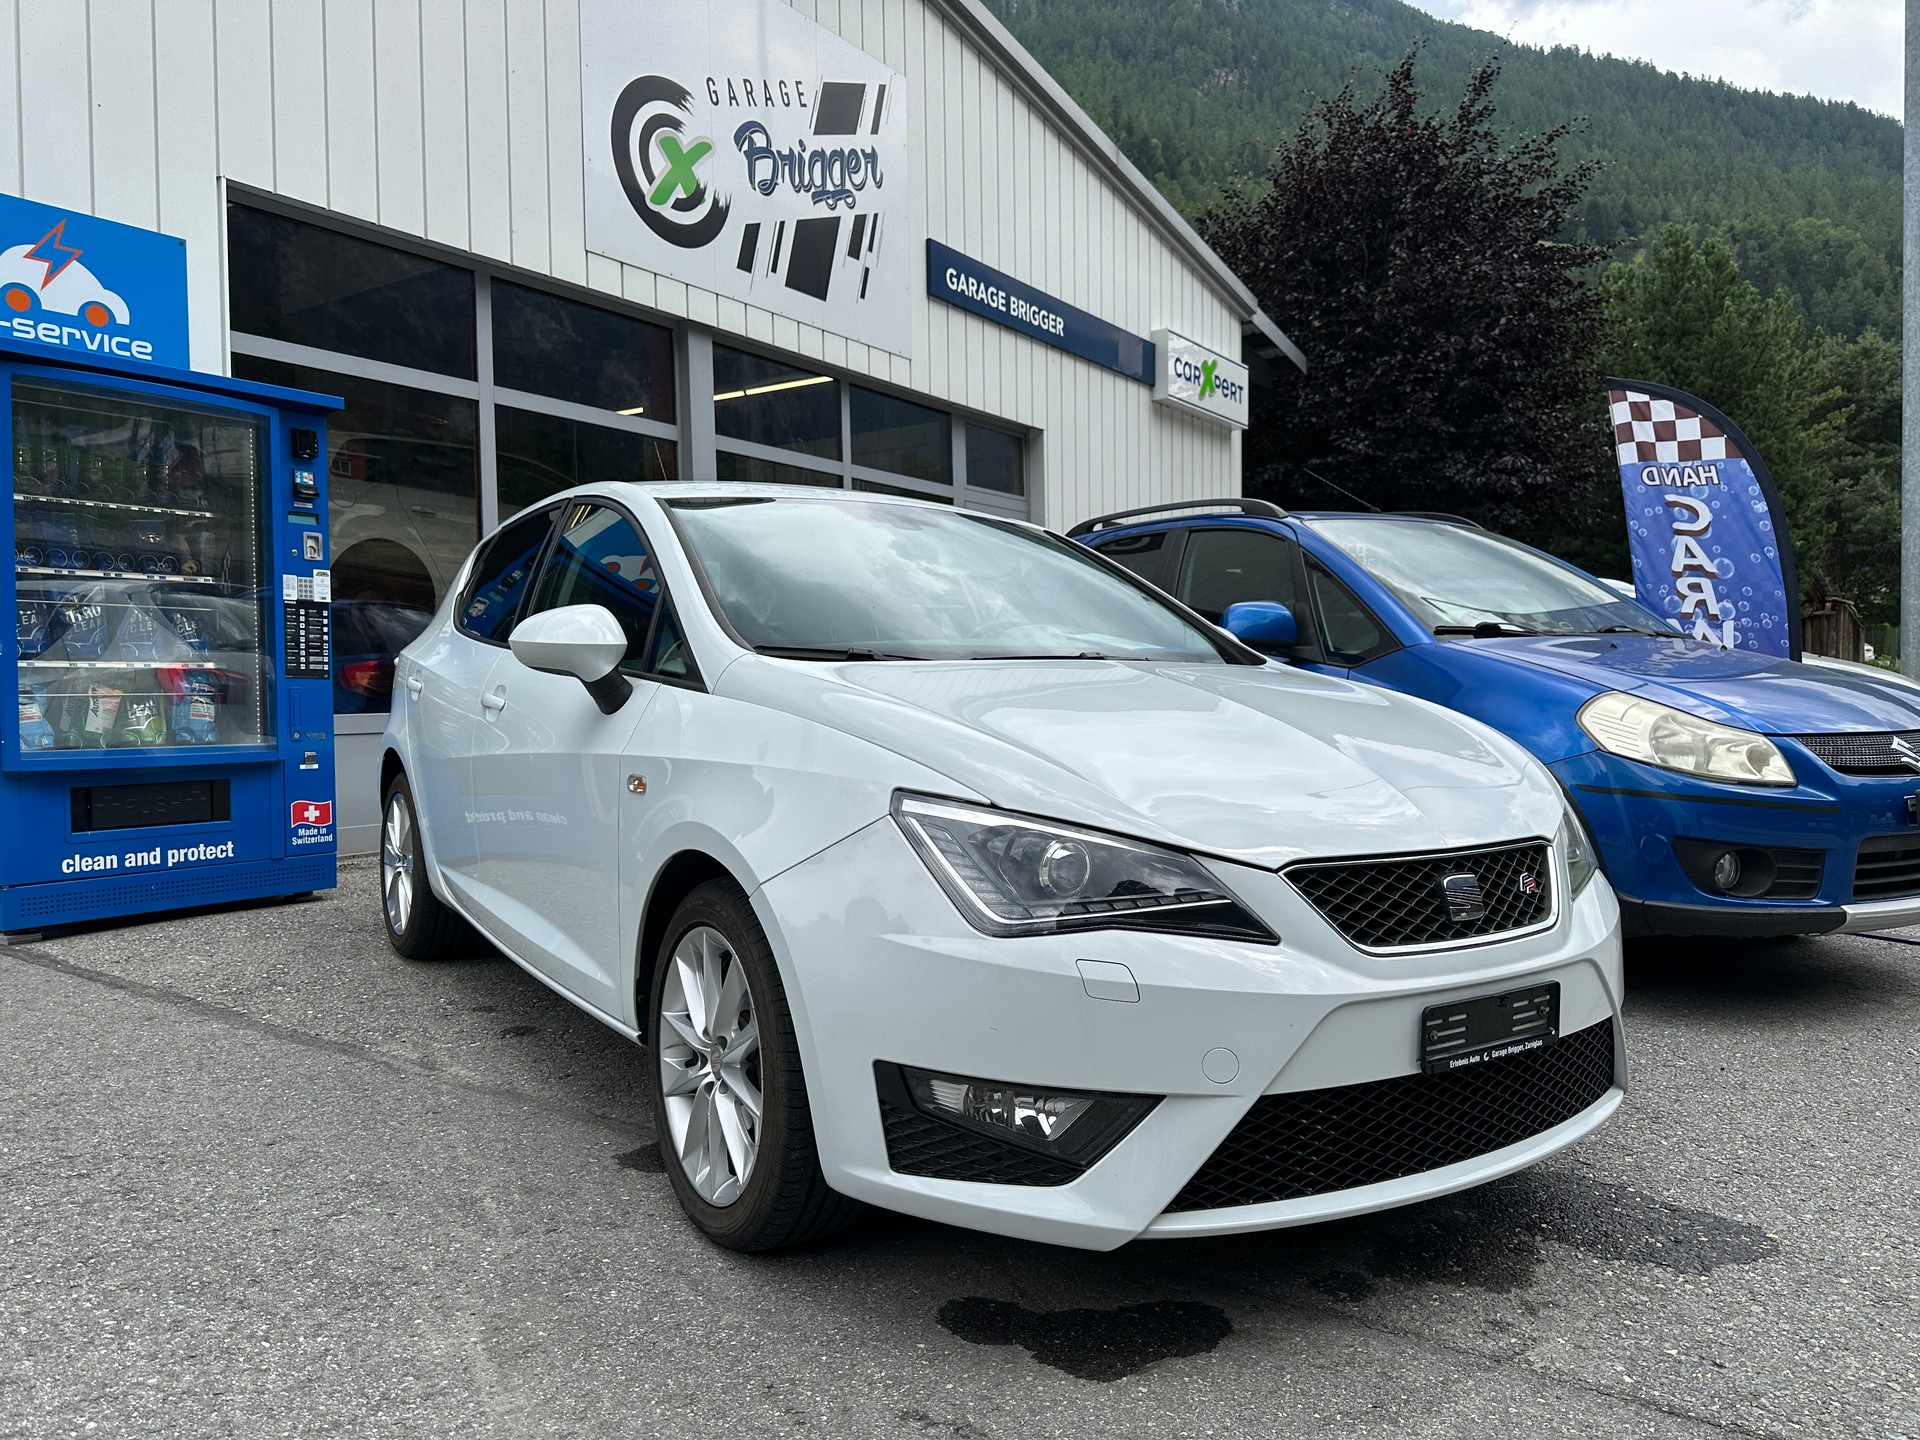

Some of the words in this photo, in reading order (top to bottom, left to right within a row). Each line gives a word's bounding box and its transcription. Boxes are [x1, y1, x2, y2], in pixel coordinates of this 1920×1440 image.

[706, 77, 807, 108] GARAGE
[733, 120, 883, 210] Brigger
[946, 268, 1007, 312] GARAGE
[1010, 295, 1064, 337] BRIGGER
[292, 834, 333, 845] Switzerland
[298, 828, 318, 836] Made
[61, 854, 118, 874] clean
[124, 847, 161, 867] and
[167, 841, 234, 867] protect
[1469, 1055, 1480, 1064] Auto
[1492, 1048, 1508, 1058] Garage
